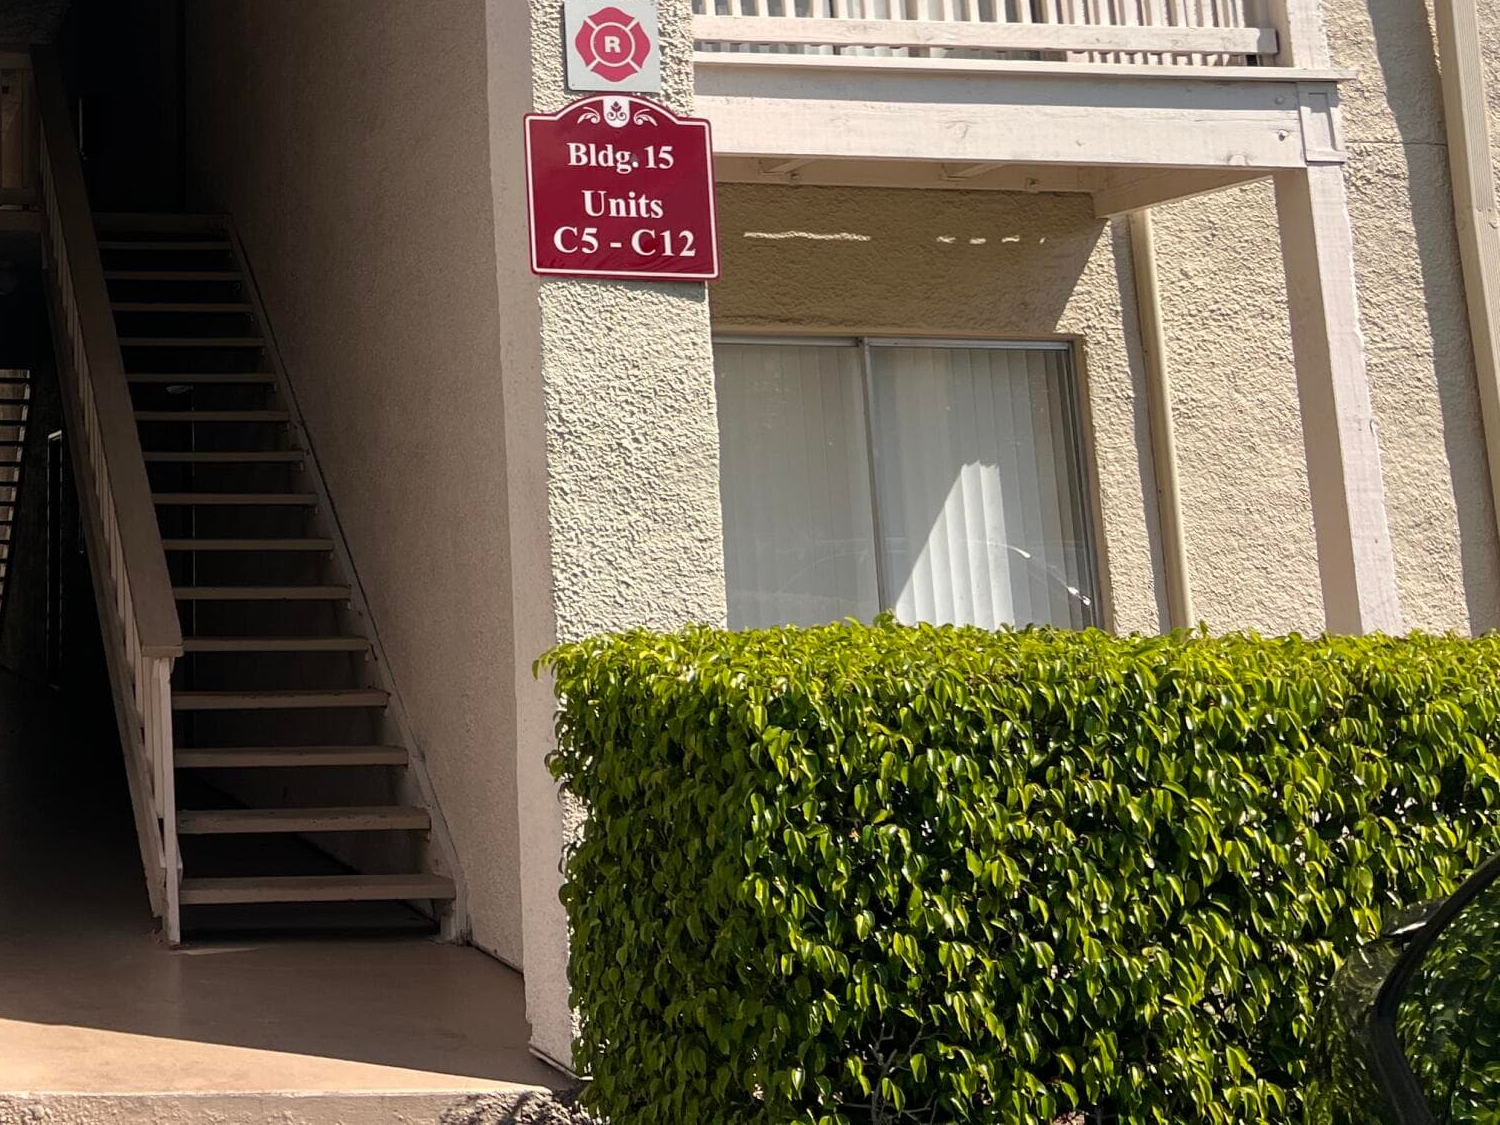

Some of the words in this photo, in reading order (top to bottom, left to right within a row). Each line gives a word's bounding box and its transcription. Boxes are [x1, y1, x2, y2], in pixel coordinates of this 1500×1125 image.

[604, 35, 621, 53] R
[566, 142, 639, 174] Bldg.
[644, 145, 675, 169] 15
[581, 189, 664, 219] Units
[553, 226, 599, 254] C5
[630, 229, 696, 257] C12
